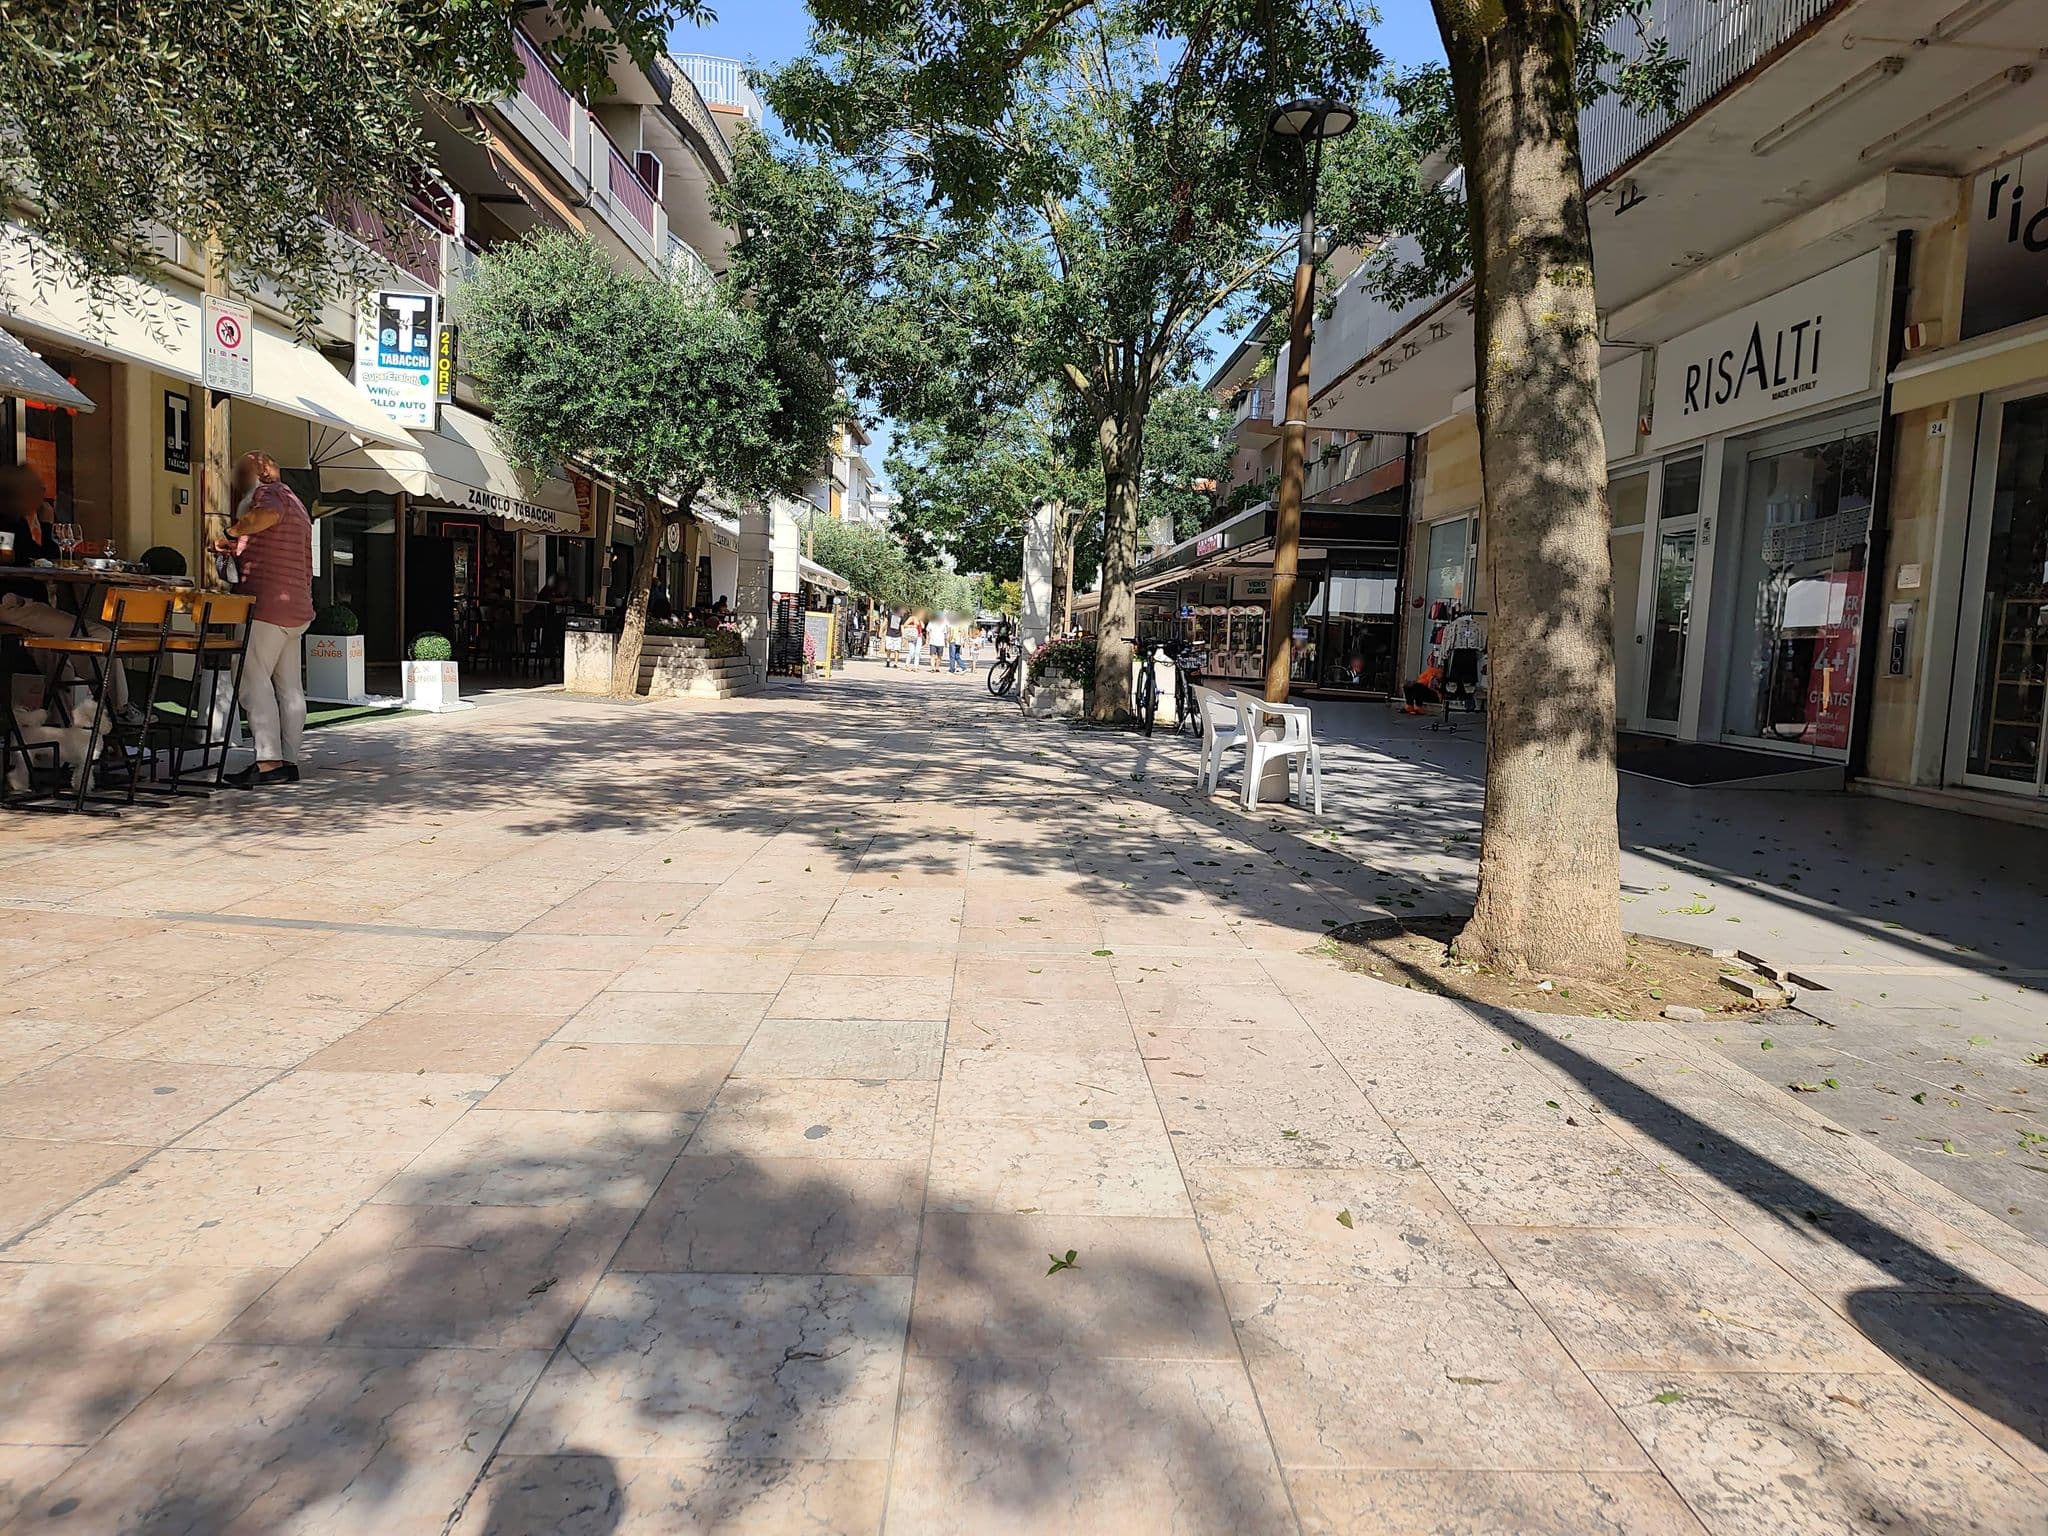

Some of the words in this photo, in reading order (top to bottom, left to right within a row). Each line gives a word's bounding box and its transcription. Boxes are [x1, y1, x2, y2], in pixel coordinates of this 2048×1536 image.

[440, 332, 450, 356] 24
[380, 353, 430, 368] TABACCHI
[439, 358, 451, 395] ORE
[1771, 388, 1790, 400] MADE
[1790, 386, 1799, 396] IN
[1799, 380, 1818, 393] ITALY
[399, 401, 427, 410] AUTO
[1932, 423, 1942, 434] 24
[468, 489, 510, 512] ZAMOLO
[514, 502, 556, 524] TABACCHI
